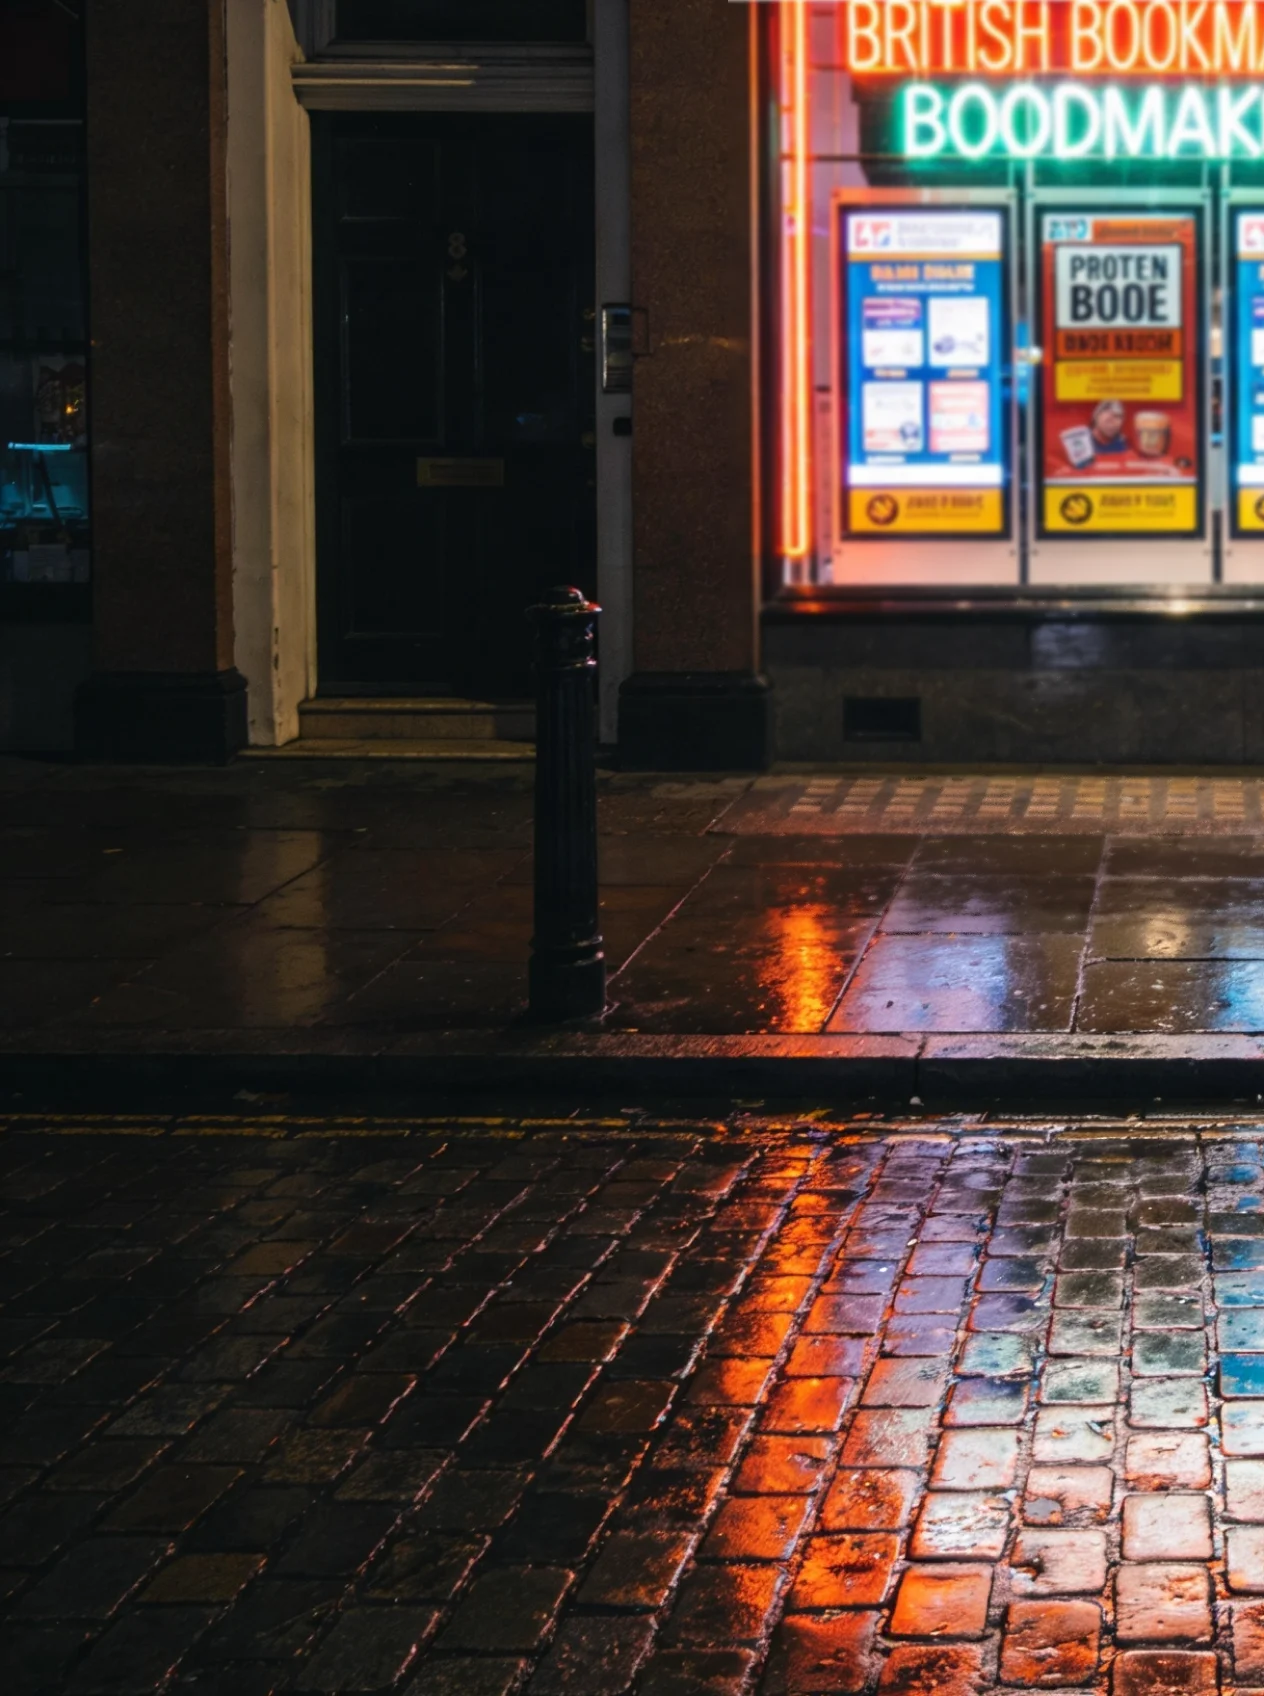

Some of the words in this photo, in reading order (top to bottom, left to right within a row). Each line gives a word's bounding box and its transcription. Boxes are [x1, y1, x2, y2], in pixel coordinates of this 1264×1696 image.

[847, 0, 1049, 71] BRITISH
[1070, 254, 1168, 281] PROTEN
[1070, 283, 1169, 323] BOOE
